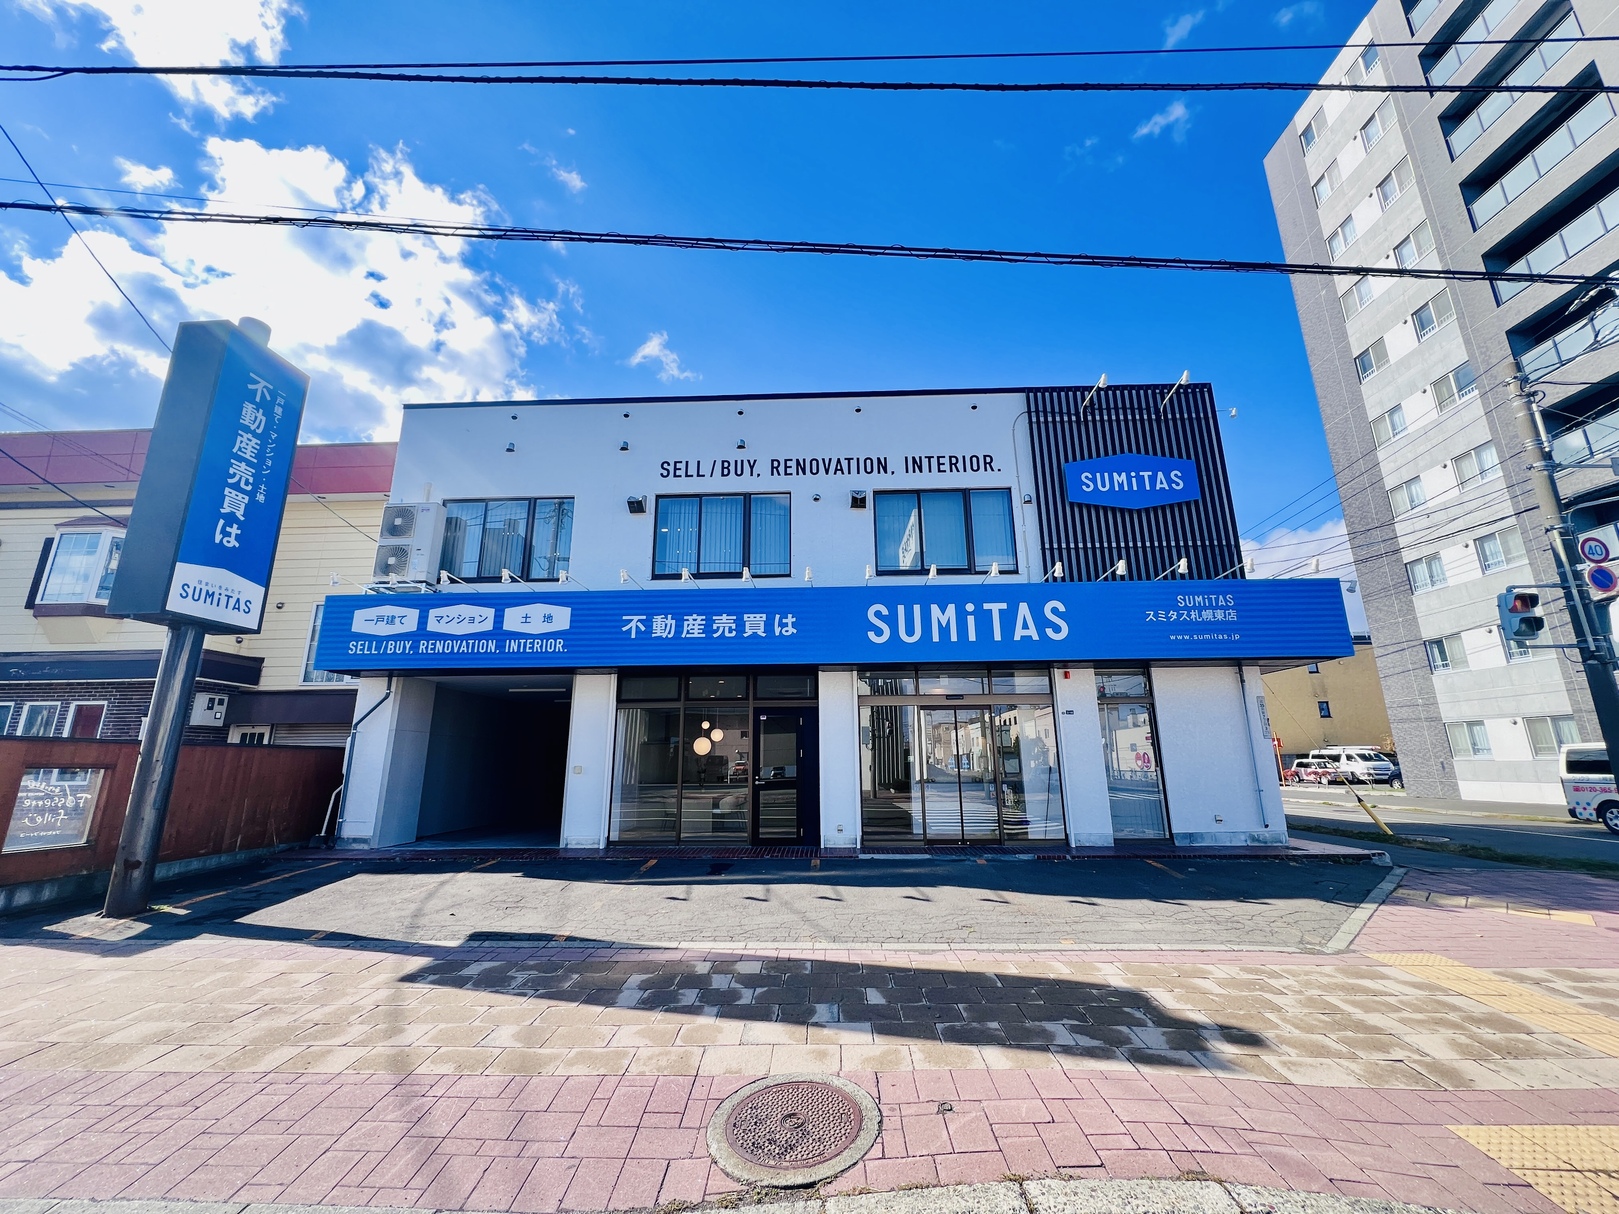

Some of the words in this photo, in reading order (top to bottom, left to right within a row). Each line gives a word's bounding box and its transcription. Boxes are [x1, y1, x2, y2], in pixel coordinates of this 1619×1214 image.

[214, 372, 274, 548] 不動産売買は
[660, 459, 761, 479] SELL/BUY,
[770, 456, 896, 476] RENOVATION,
[904, 454, 1002, 474] INTERIOR.
[1587, 544, 1604, 556] 40
[364, 614, 408, 626] 一戸建て
[434, 614, 489, 625] マンション
[1145, 609, 1237, 622] スミタス札幌東店
[621, 613, 798, 639] 不動産売買は
[348, 640, 414, 655] SELL/BUY,
[418, 639, 500, 654] RENOVATION,
[505, 638, 568, 653] INTERIOR.
